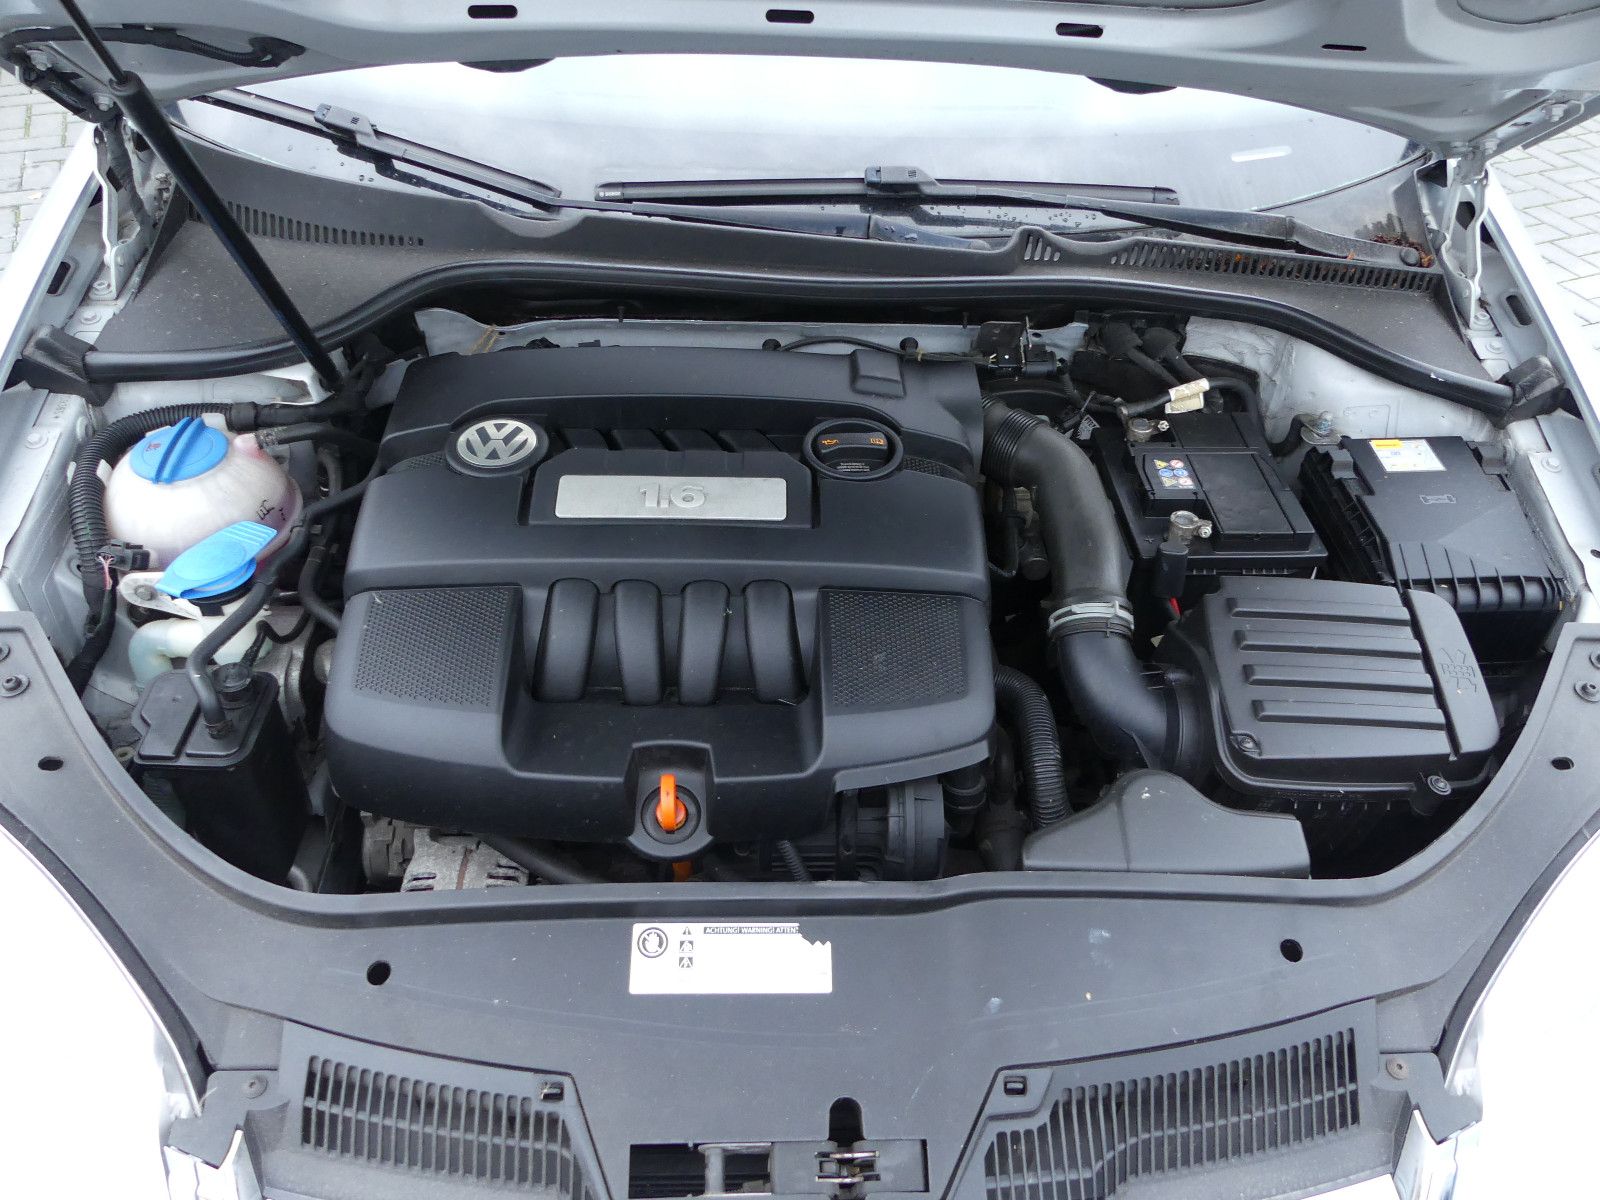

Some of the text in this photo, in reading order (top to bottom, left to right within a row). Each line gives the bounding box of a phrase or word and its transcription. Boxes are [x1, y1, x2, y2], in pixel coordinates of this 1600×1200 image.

[640, 485, 705, 508] 1.6
[705, 926, 740, 934] ACHTUNG!
[741, 926, 775, 934] WARNING!
